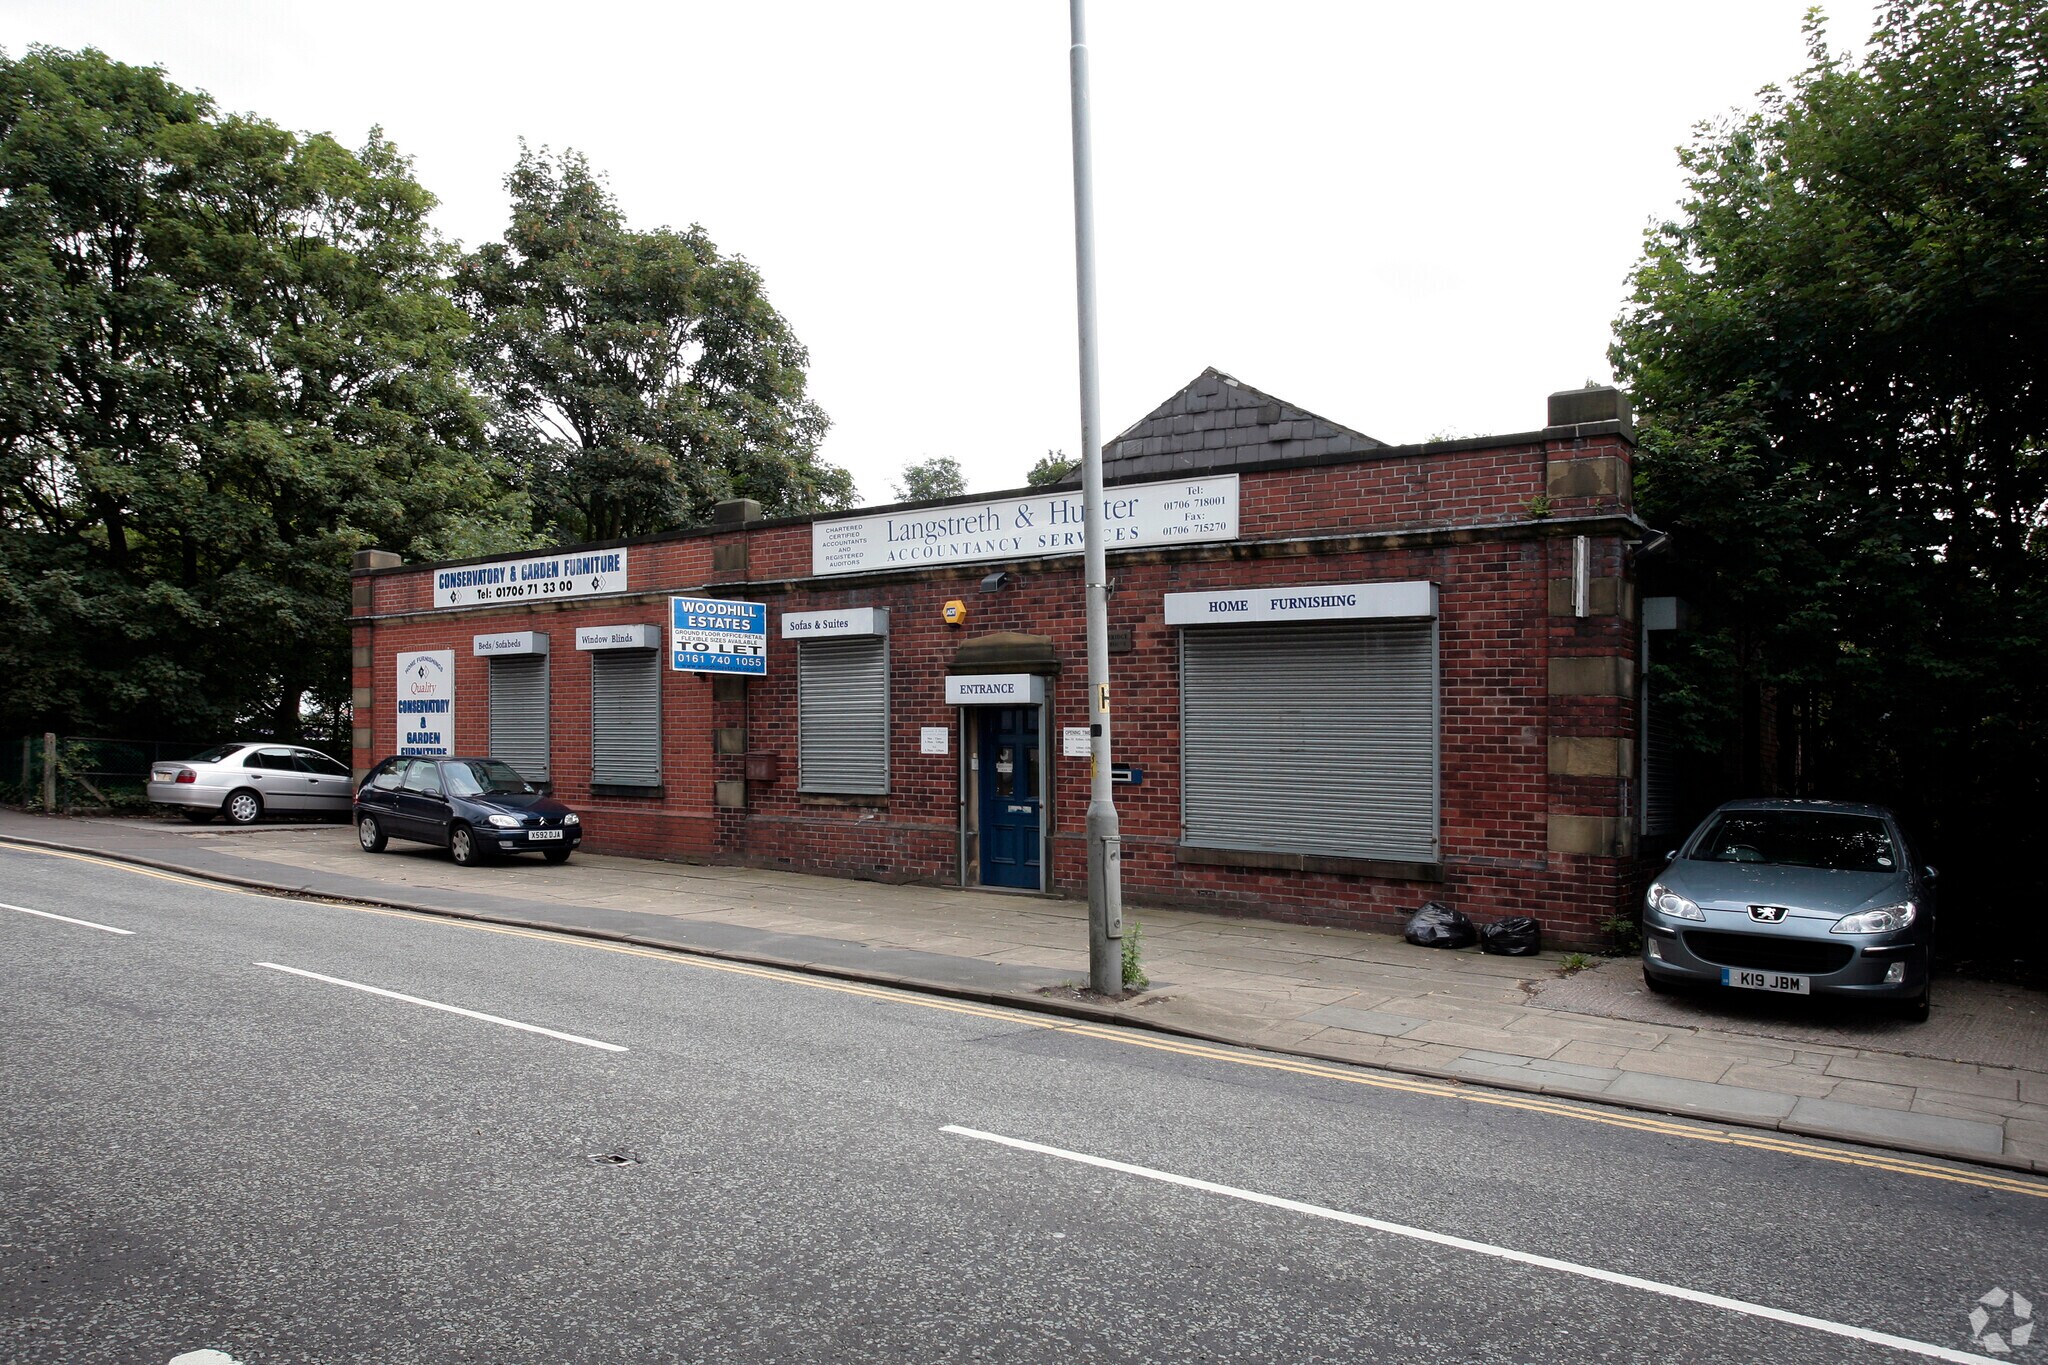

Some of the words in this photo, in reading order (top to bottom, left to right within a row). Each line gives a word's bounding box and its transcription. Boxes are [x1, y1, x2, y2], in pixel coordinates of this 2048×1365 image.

[1186, 486, 1204, 495] Tel:
[1163, 500, 1190, 511] 01706
[1194, 496, 1226, 508] 718001
[887, 506, 1001, 545] Langstreth
[1014, 503, 1034, 529] &
[1048, 498, 1139, 525] Huter
[1184, 512, 1205, 521] Fax:
[825, 524, 863, 534] CHARTERED
[828, 531, 860, 540] CERTIFIED
[1162, 525, 1189, 536] 01706
[1194, 521, 1227, 533] 715270
[822, 538, 868, 548] ACCOUNTANTS
[887, 536, 1022, 562] ACCOUNTANCY
[1038, 525, 1139, 548] SERVCES
[825, 552, 864, 561] REGISTERED
[438, 567, 506, 590] CONSERVATORY
[509, 565, 517, 582] &
[521, 561, 559, 580] GARDEN
[564, 554, 620, 576] FURNITURE
[477, 588, 492, 600] Tel:
[495, 584, 524, 598] 01706
[527, 583, 538, 595] 71
[543, 582, 556, 593] 33
[559, 580, 573, 592] 00
[682, 601, 757, 618] WOODHILL
[1208, 600, 1249, 613] HOME
[1270, 594, 1357, 610] FURNISHING
[688, 615, 751, 630] ESTATES
[789, 619, 812, 631] Sofas
[814, 620, 821, 629] &
[822, 618, 849, 629] Suites
[581, 635, 608, 644] Window
[611, 633, 633, 643] Blinds
[676, 641, 710, 652] TO
[718, 644, 762, 655] LET
[405, 659, 416, 674] HOME
[416, 655, 444, 672] FURNISHINGS
[678, 653, 705, 663] 0161
[710, 655, 731, 665] 740
[736, 657, 762, 667] 1055
[410, 682, 437, 696] Quality
[959, 683, 1015, 694] ENTRANCE
[398, 699, 450, 713] CONSERVATORY
[420, 716, 427, 728] &
[406, 732, 440, 744] GARDEN
[401, 747, 447, 755] FURNITURE
[1741, 972, 1765, 987] K19
[1769, 976, 1800, 991] JBM
